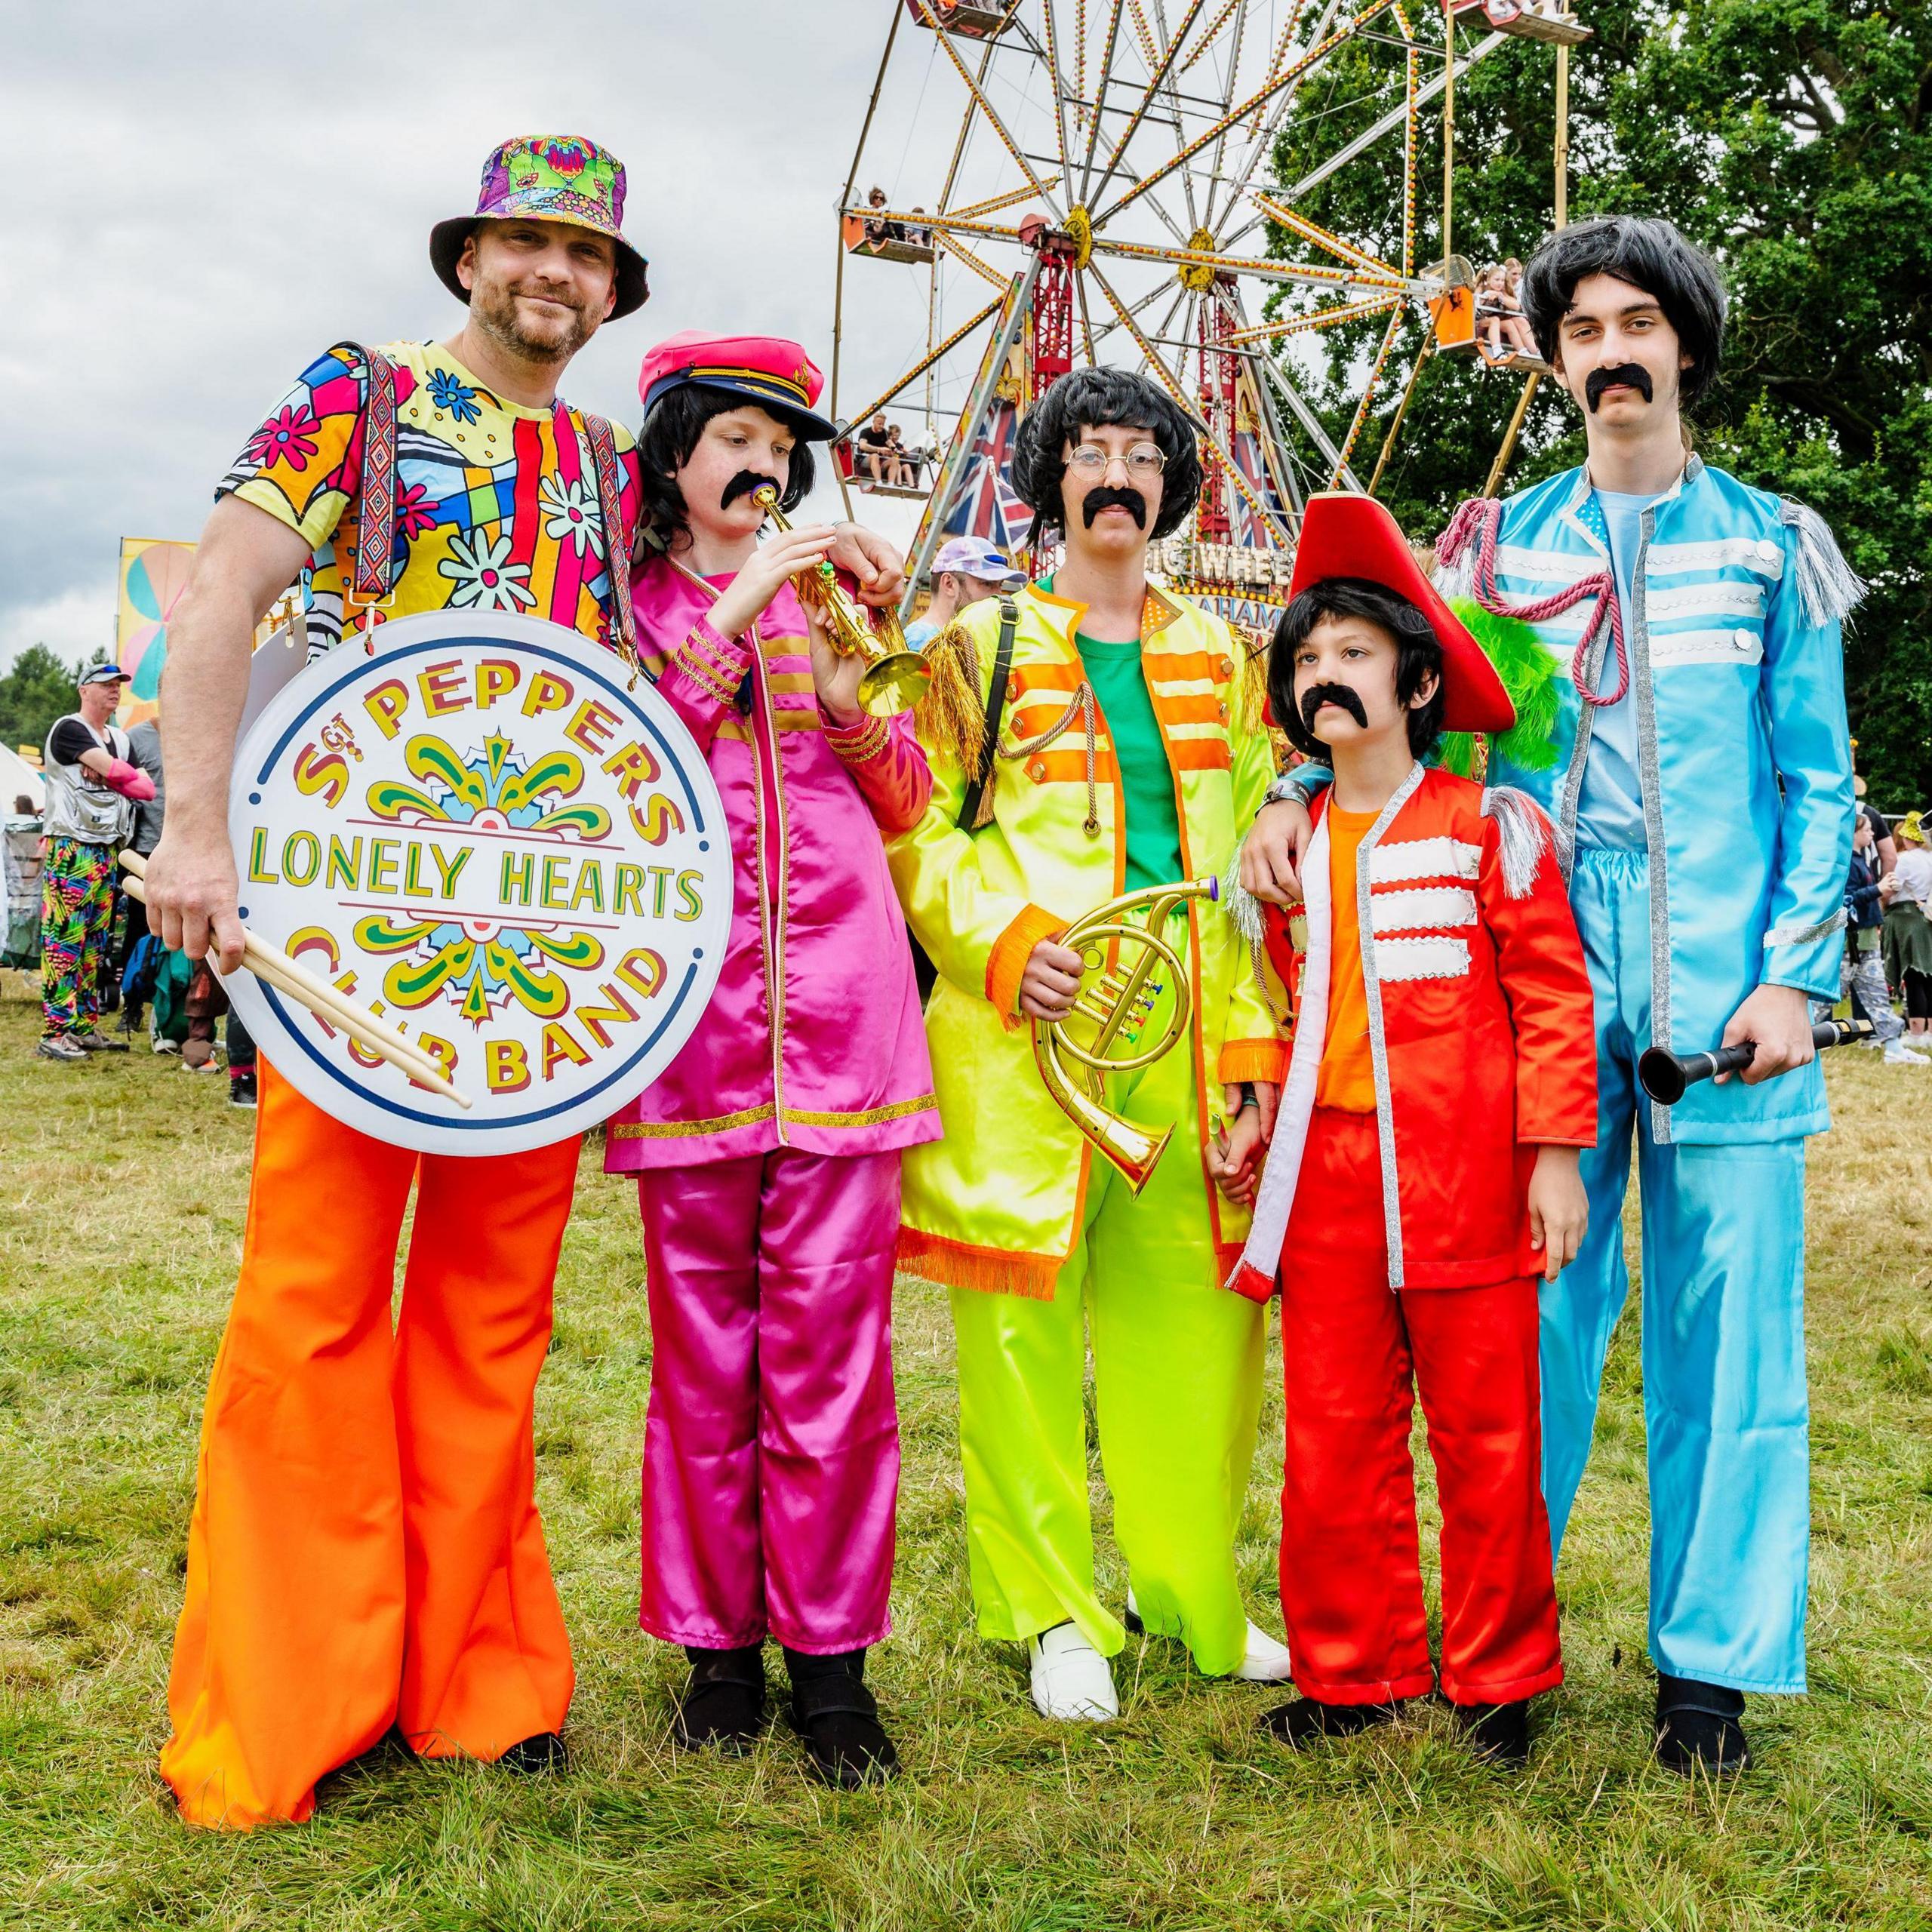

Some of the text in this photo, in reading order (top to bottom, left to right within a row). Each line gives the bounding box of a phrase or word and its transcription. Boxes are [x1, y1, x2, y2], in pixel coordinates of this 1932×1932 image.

[1146, 538, 1295, 586] IG WHEE
[1187, 596, 1284, 632] AHAM
[363, 658, 685, 847] PEPPERS
[248, 826, 704, 922] LONELY HEARTS
[486, 946, 668, 1094] BAND
